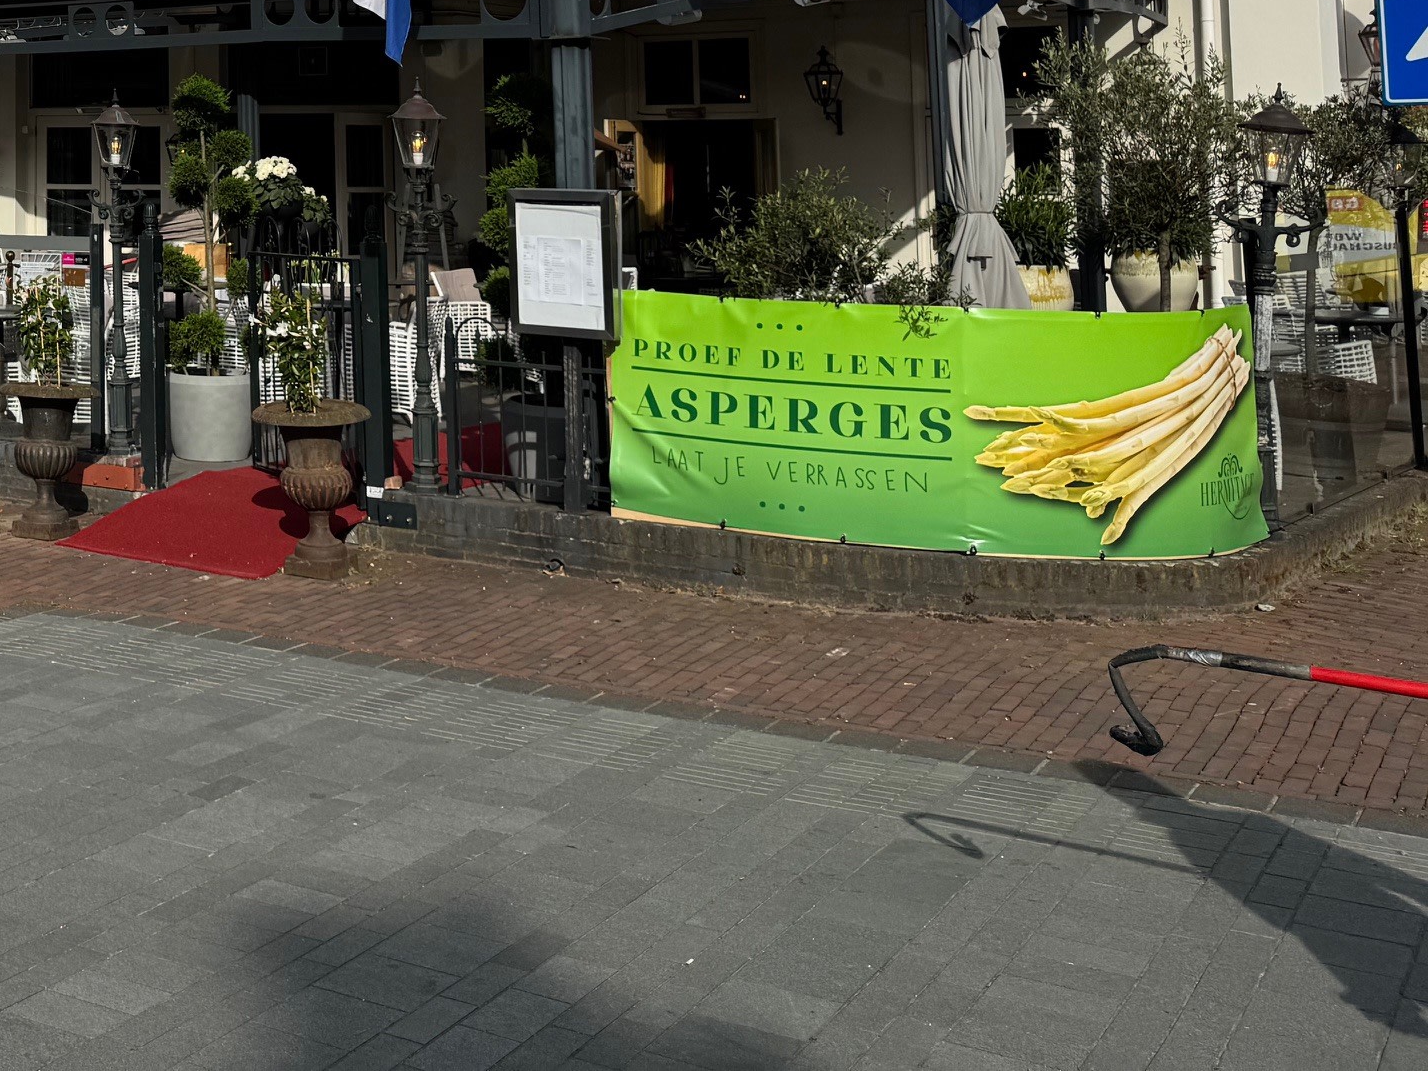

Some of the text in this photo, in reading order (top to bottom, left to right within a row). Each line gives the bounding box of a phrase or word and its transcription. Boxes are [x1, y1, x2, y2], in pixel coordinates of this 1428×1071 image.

[631, 338, 952, 379] PROEF DE LENTE
[632, 383, 953, 444] ASPERGES
[651, 446, 930, 493] LAAT JE VERRASSEN
